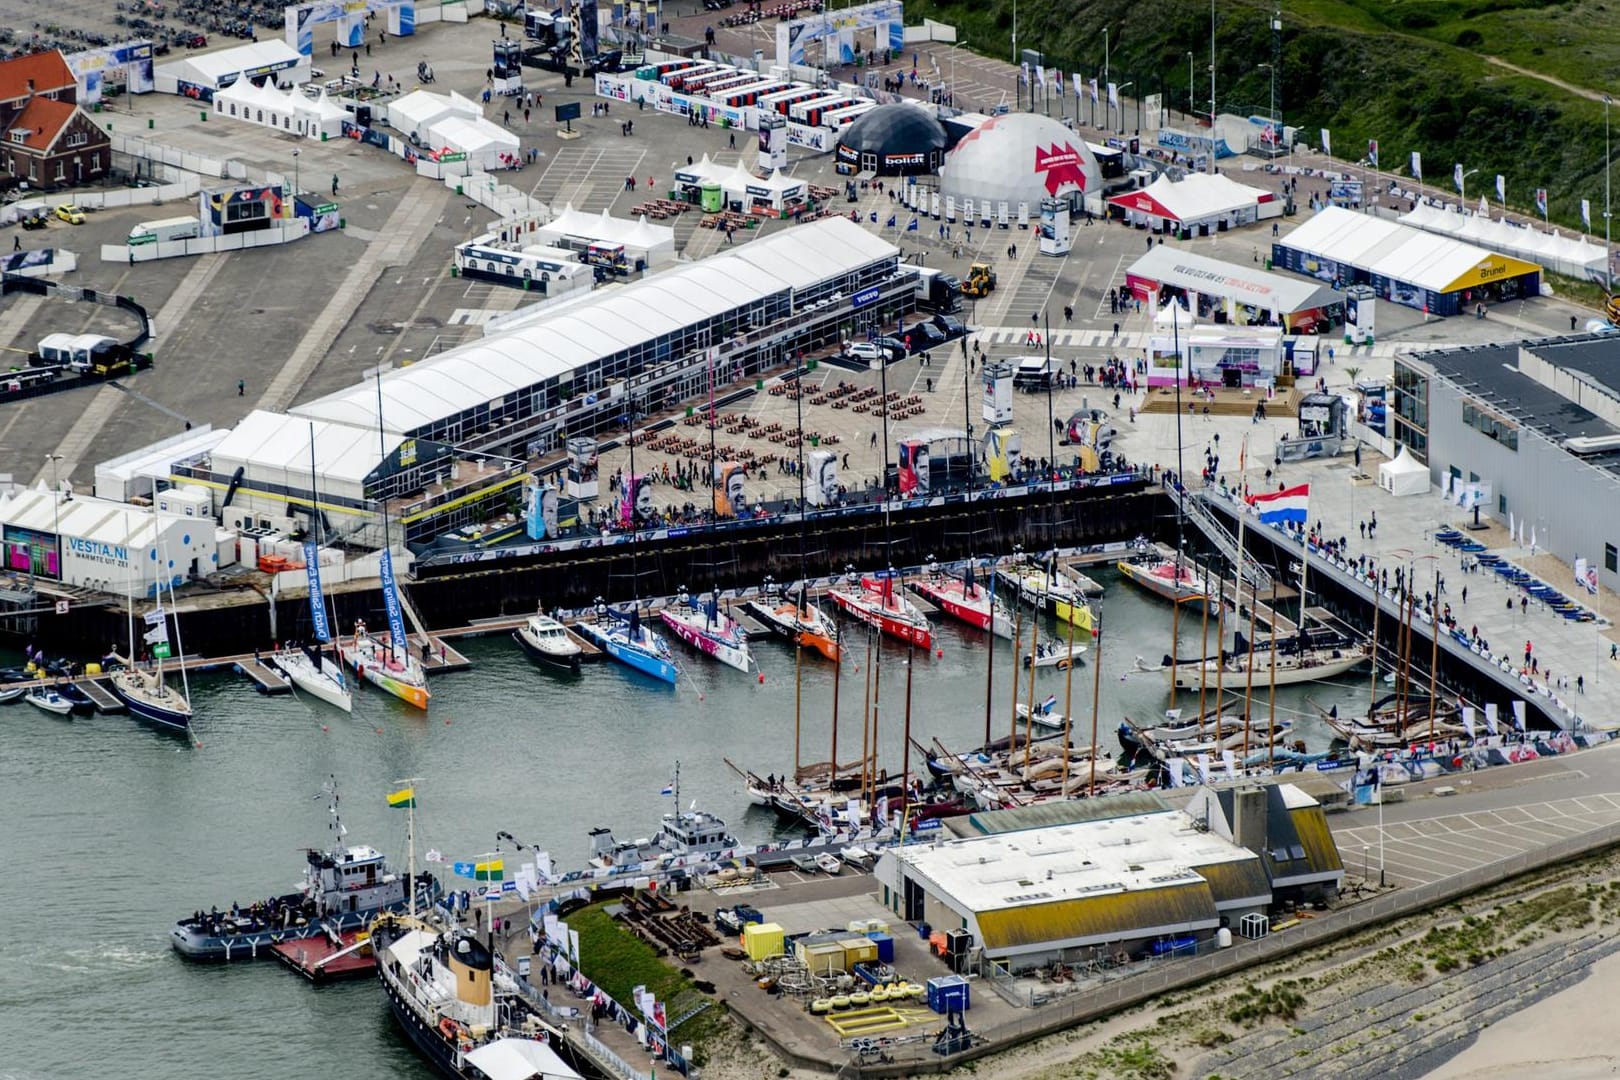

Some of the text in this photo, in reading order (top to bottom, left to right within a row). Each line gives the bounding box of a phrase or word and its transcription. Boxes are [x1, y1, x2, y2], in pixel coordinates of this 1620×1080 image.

[1480, 264, 1506, 278] Brunel
[857, 291, 879, 303] VOLVO
[69, 537, 128, 561] VESTIA.NL
